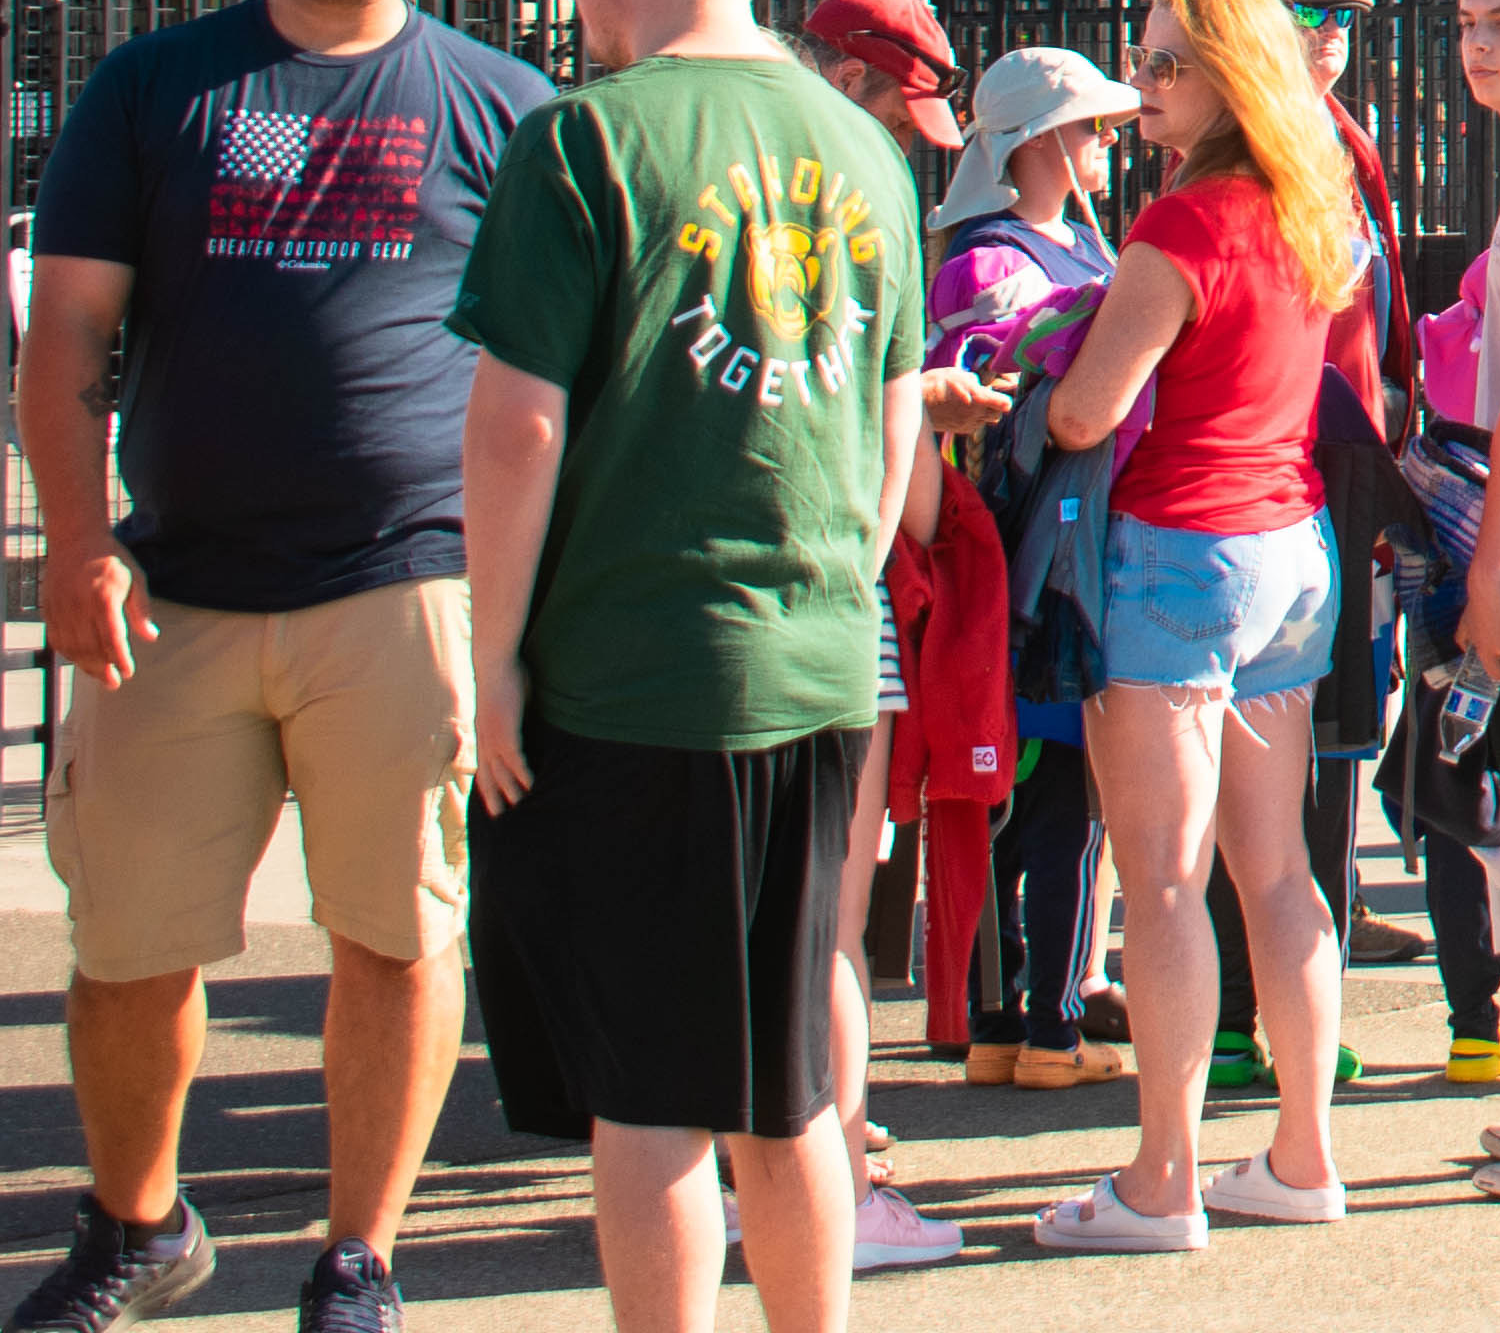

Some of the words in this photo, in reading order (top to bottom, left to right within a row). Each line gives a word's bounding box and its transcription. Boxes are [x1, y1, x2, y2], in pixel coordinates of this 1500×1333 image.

[677, 153, 885, 265] STANDING
[206, 237, 275, 256] GREATER
[283, 240, 361, 258] OUTDOOR
[371, 241, 414, 259] GEAR
[287, 259, 332, 270] Columbia
[672, 292, 877, 407] TOGETHER
